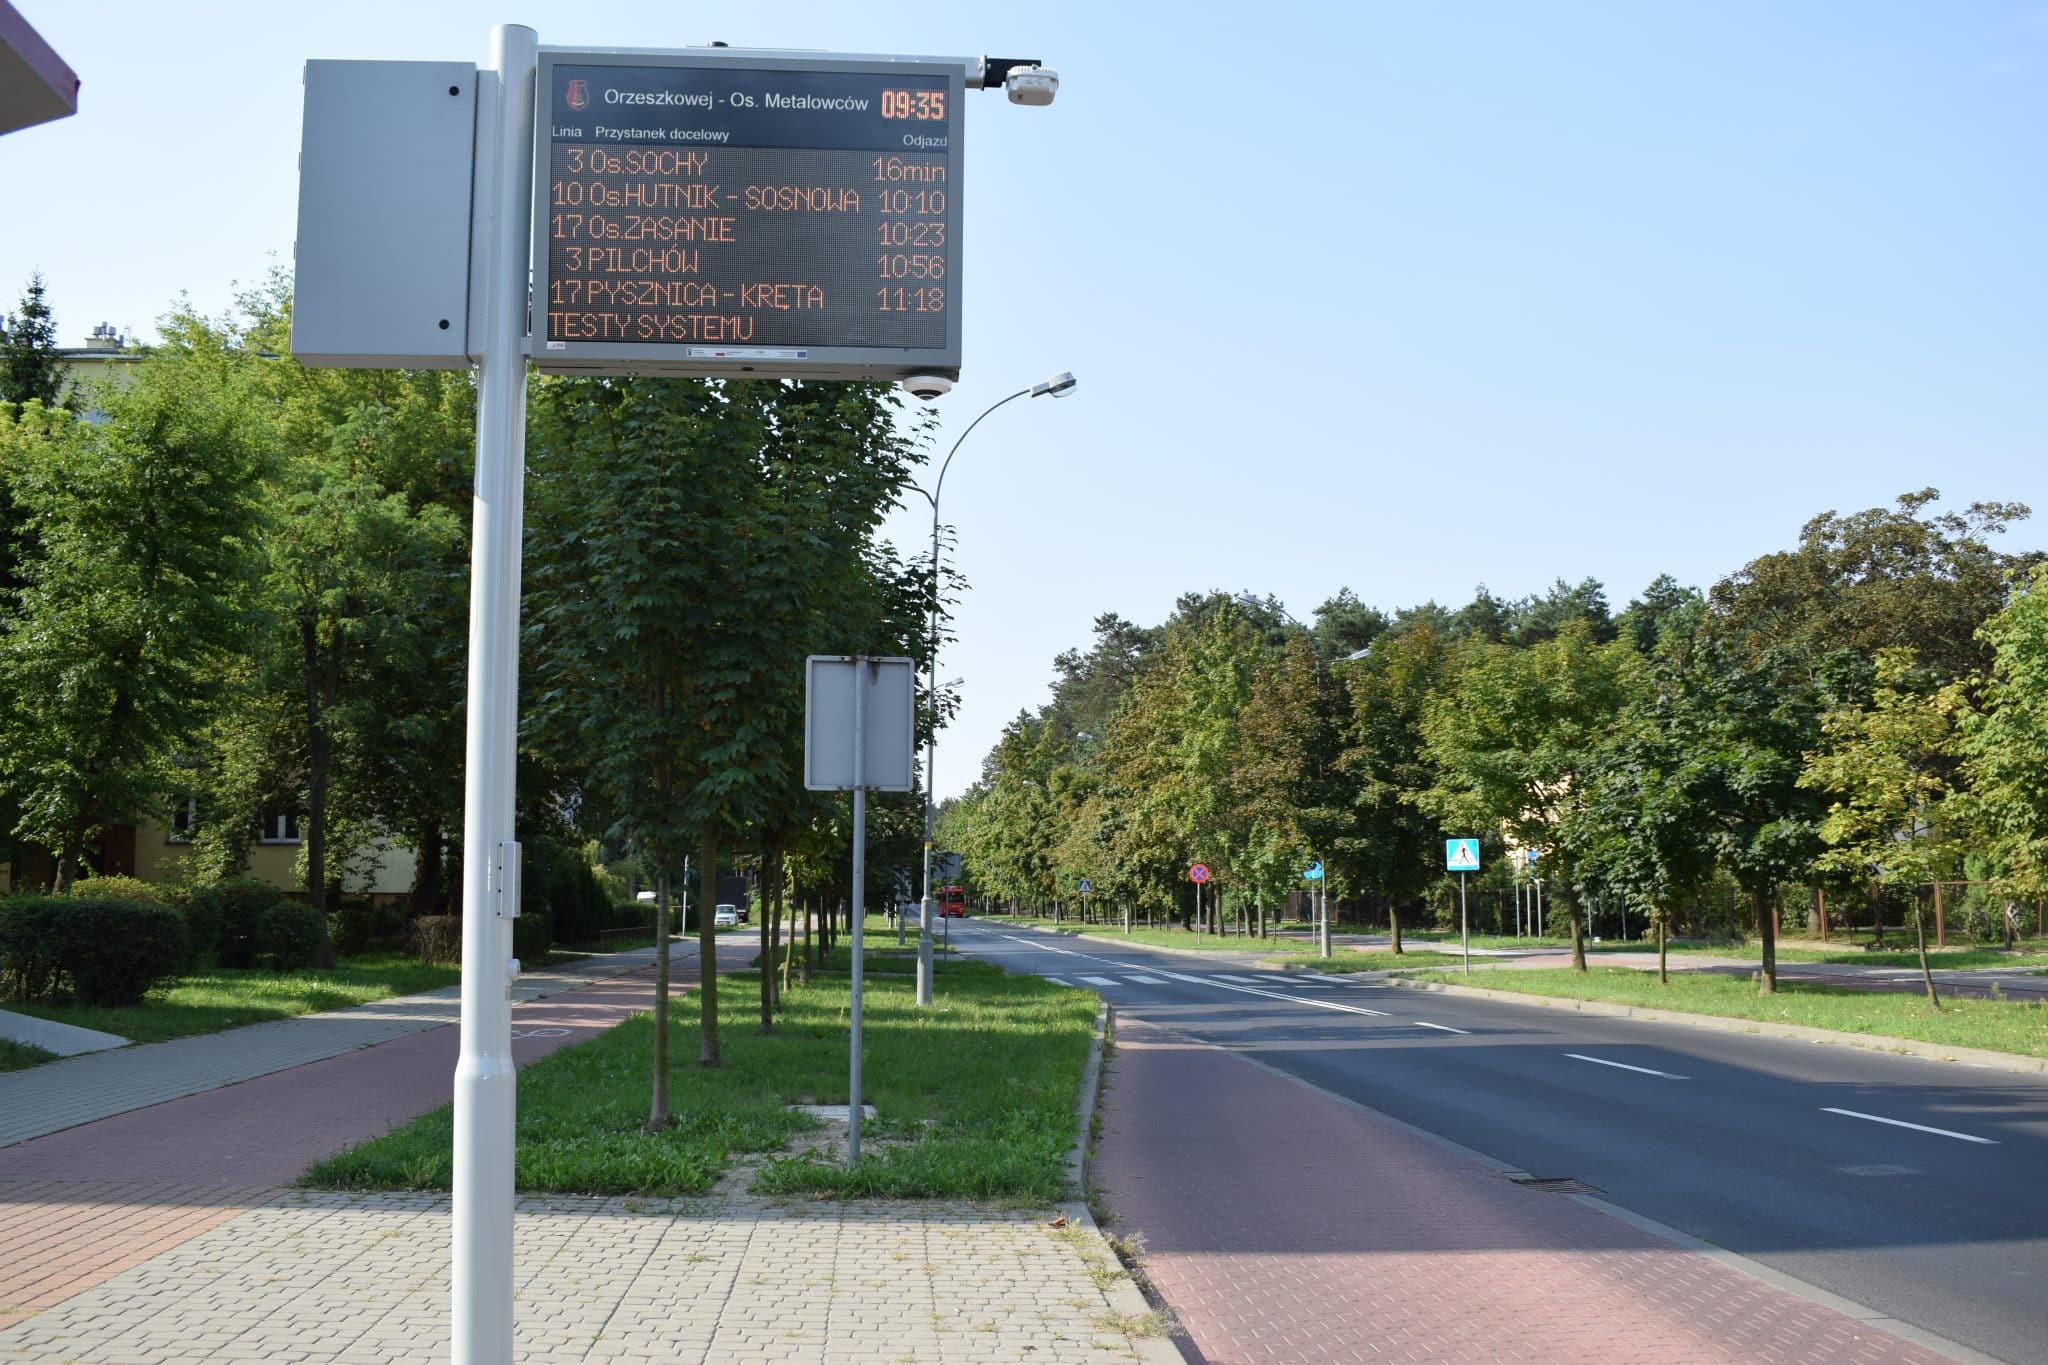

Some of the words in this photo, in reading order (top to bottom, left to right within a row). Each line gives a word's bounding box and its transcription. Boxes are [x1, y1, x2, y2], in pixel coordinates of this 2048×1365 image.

[604, 89, 713, 110] Orzeszkowej
[730, 92, 759, 108] Os.
[765, 93, 869, 111] Metalowców
[881, 90, 944, 120] 09:35
[552, 126, 582, 137] Linia
[595, 126, 666, 141] Przystanek
[670, 128, 730, 143] docelowy
[903, 134, 948, 149] Odjazd
[567, 149, 583, 173] 3
[872, 157, 945, 183] 16min
[553, 181, 583, 205] 10
[744, 185, 860, 213] SOSNOWA
[879, 189, 946, 214] 10:10
[553, 214, 583, 238] 17
[879, 222, 945, 247] 10:23
[566, 247, 582, 271] 3
[588, 243, 698, 273] PILCHÓW
[879, 254, 945, 279] 10:56
[552, 279, 582, 304] 17
[588, 280, 716, 307] PYSZNICA
[877, 287, 945, 312] 11:18
[549, 312, 631, 338] TESTY
[638, 314, 753, 340] SYSTEMU
